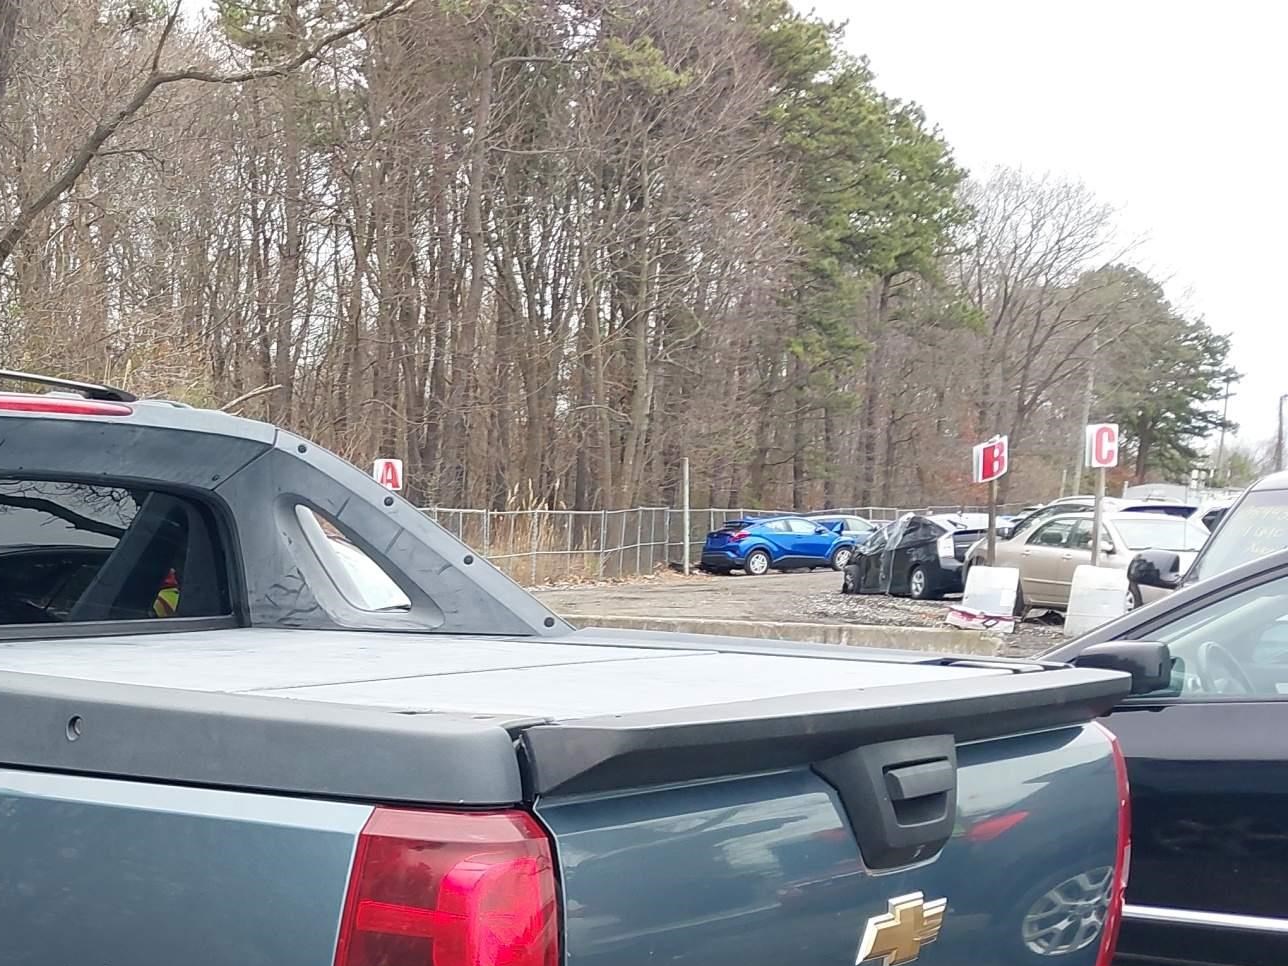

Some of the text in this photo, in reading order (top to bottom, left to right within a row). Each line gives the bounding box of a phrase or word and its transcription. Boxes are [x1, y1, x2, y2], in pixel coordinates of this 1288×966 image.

[982, 441, 1005, 481] B
[1094, 426, 1115, 465] C
[380, 461, 401, 489] A
